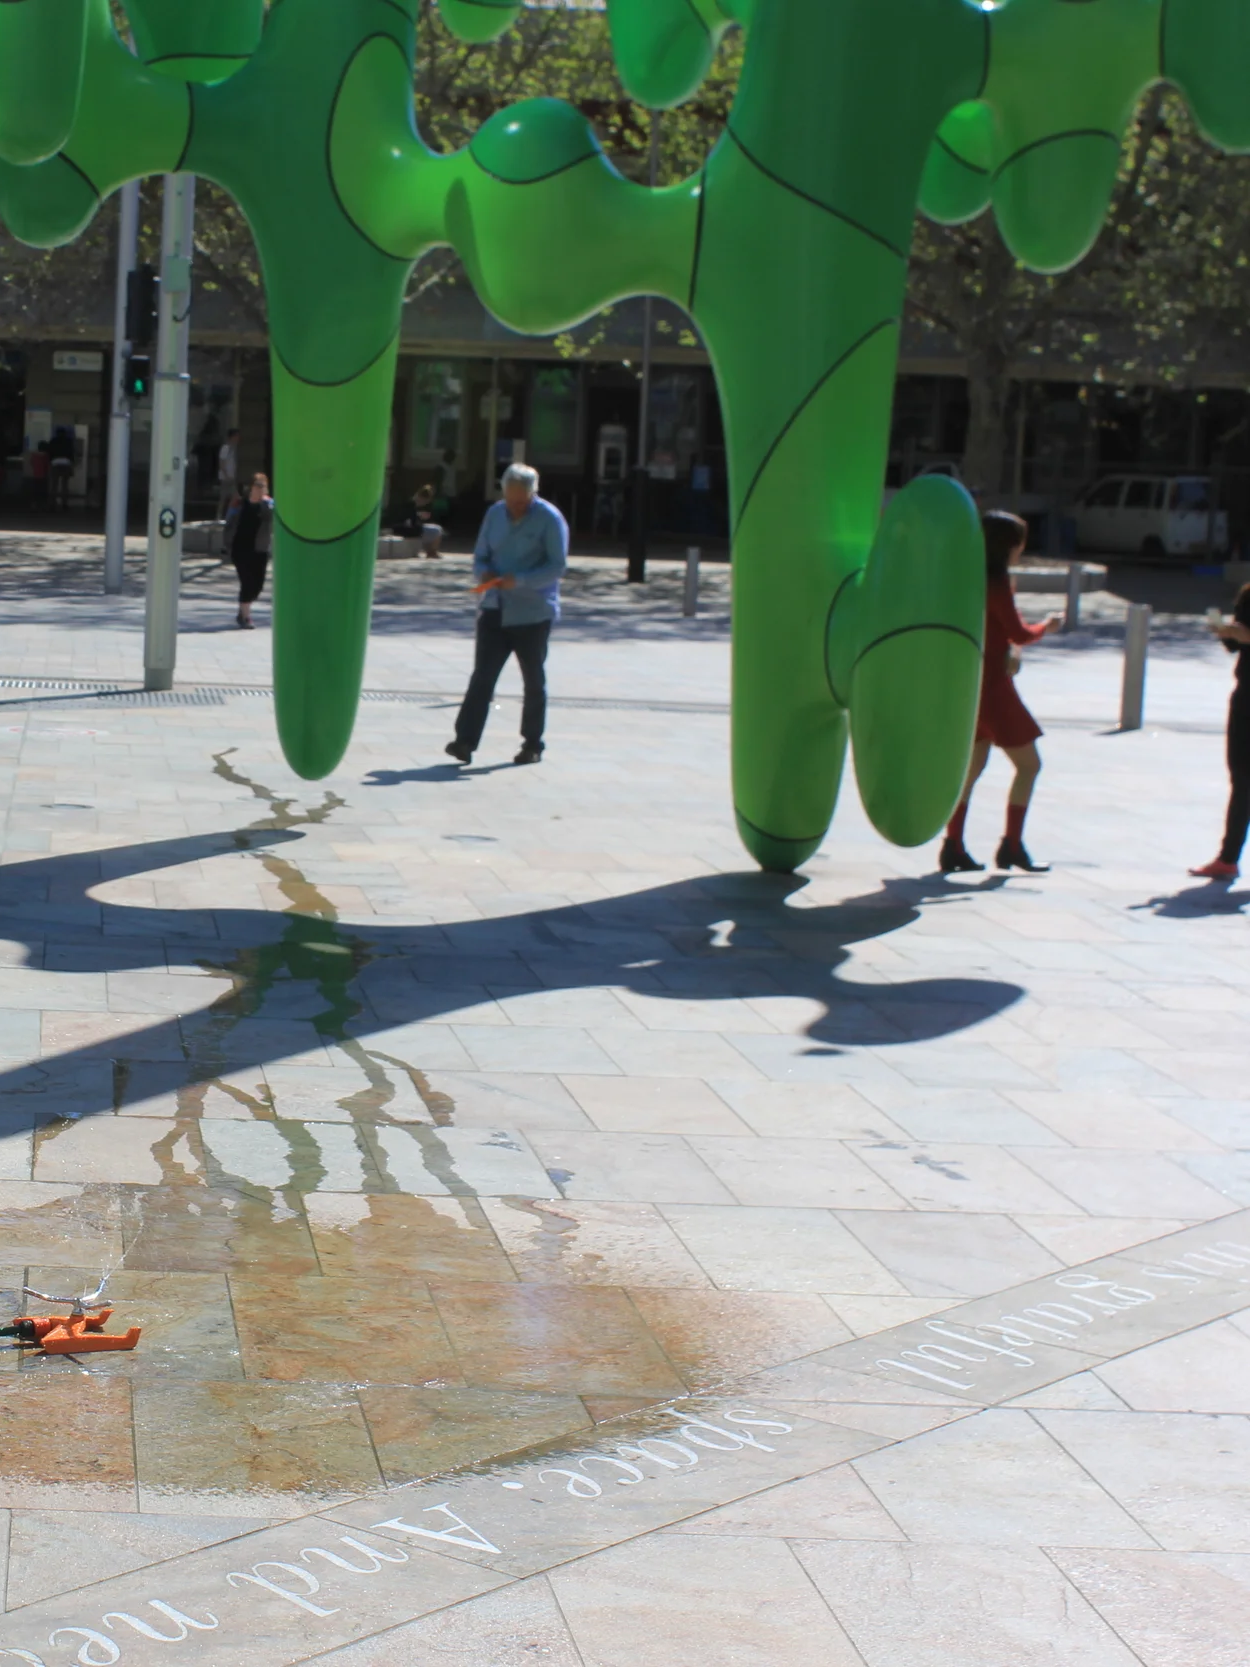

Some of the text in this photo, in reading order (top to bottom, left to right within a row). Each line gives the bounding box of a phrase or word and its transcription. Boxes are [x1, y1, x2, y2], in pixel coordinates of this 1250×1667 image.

[875, 1273, 1155, 1390] grateful
[501, 1406, 794, 1498] space.
[225, 1502, 502, 1618] And
